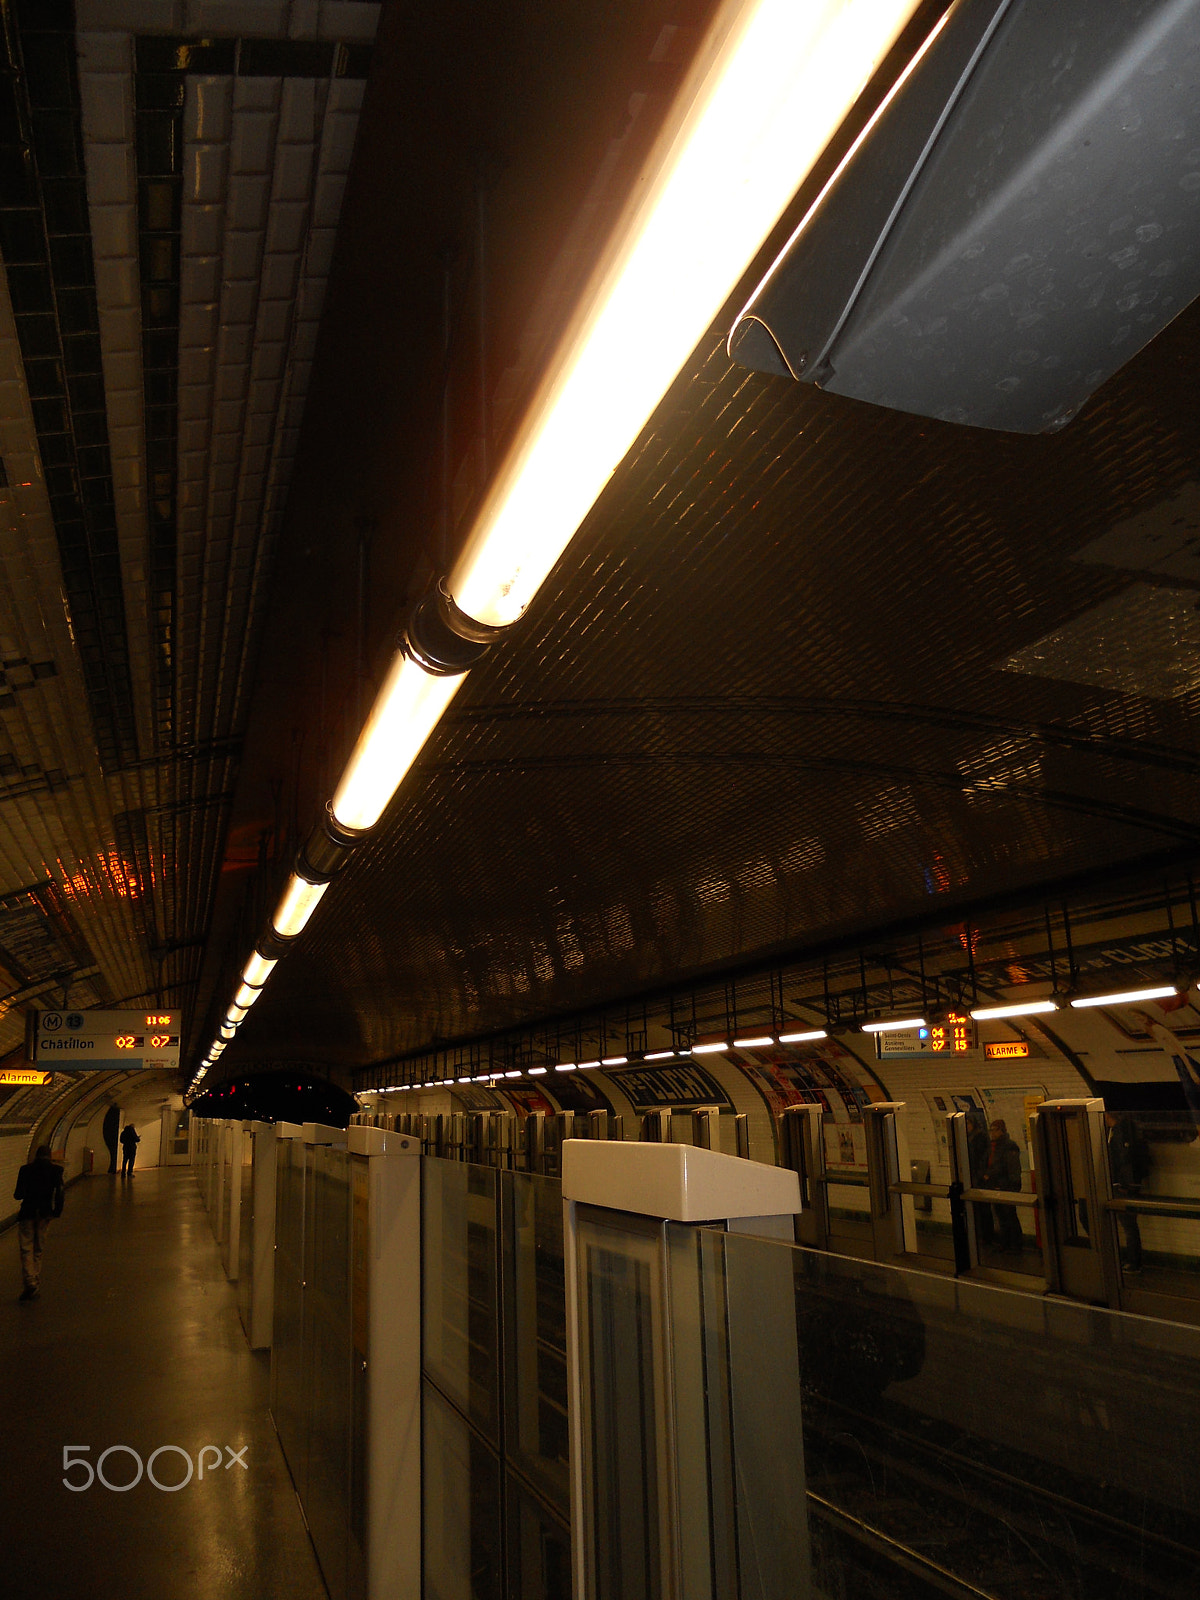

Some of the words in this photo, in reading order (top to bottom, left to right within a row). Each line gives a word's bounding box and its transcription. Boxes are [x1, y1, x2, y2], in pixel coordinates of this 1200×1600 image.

[1101, 937, 1198, 964] CLICHY
[68, 1016, 82, 1028] 13
[932, 1028, 945, 1039] 04
[954, 1028, 966, 1038] 11
[41, 1037, 94, 1050] Châtillon
[116, 1036, 135, 1049] 02
[151, 1035, 170, 1048] 07
[932, 1040, 945, 1051] 07
[954, 1040, 967, 1051] 15
[986, 1046, 1018, 1057] ALARME
[0, 1072, 38, 1083] Alarme
[636, 1067, 716, 1101] CLICHY
